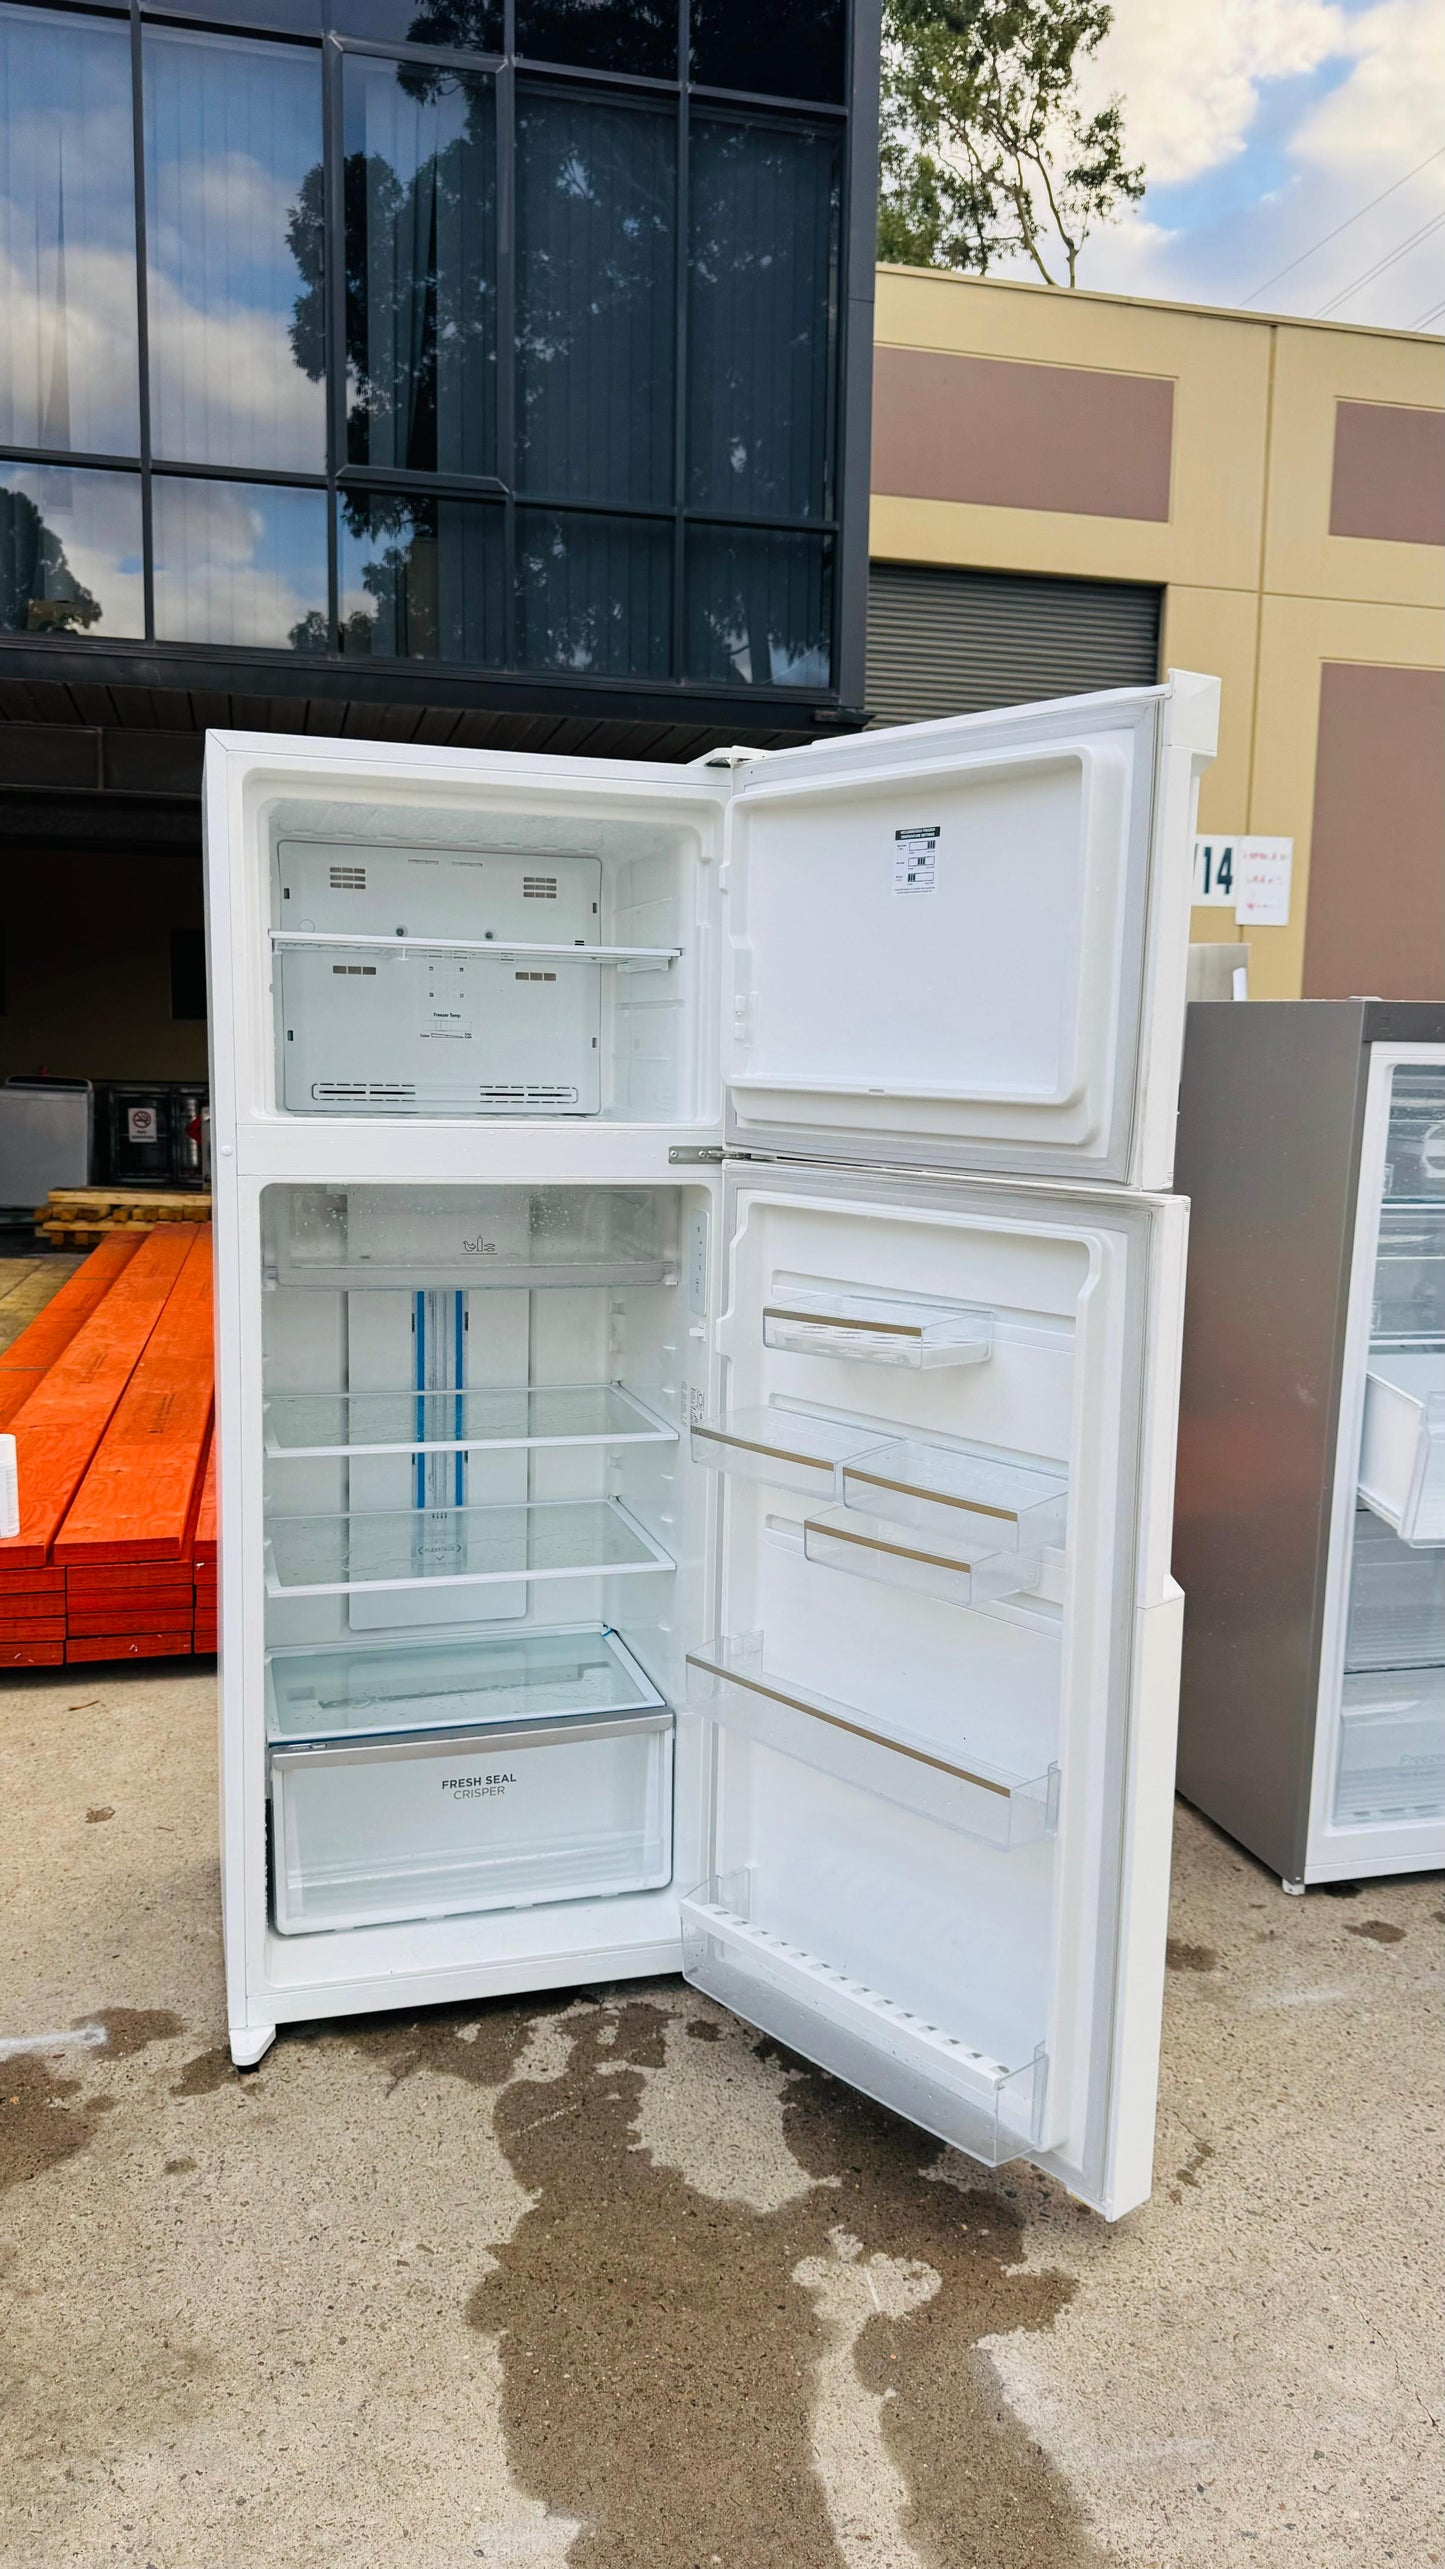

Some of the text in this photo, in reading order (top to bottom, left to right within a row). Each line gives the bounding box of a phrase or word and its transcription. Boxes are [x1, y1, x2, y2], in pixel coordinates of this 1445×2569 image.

[1193, 842, 1233, 895] 14
[441, 1773, 517, 1789] FRESH SEAL
[453, 1785, 505, 1800] CRISPER
